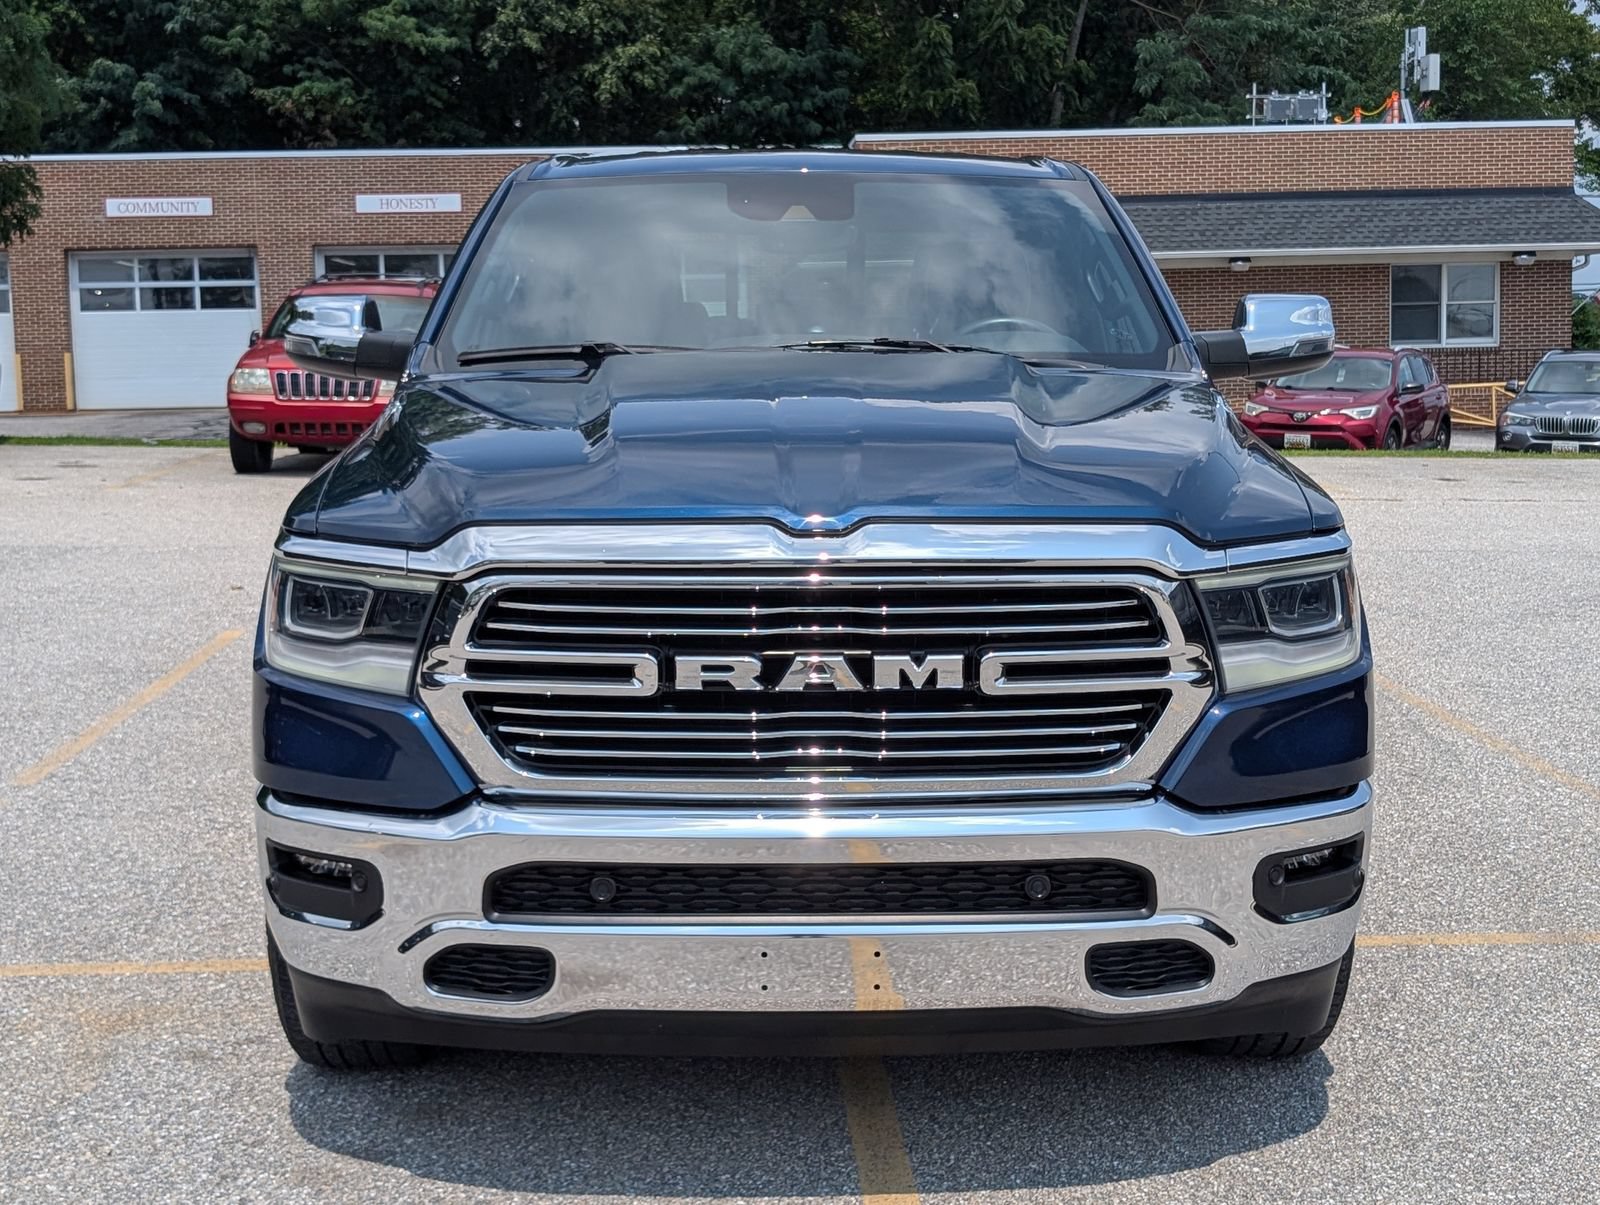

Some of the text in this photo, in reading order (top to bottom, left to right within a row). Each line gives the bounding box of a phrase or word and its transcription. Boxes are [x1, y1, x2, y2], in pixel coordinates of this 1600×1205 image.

[117, 201, 199, 214] COMMUNITY
[380, 198, 438, 210] HONESTY
[675, 653, 964, 691] RAM
